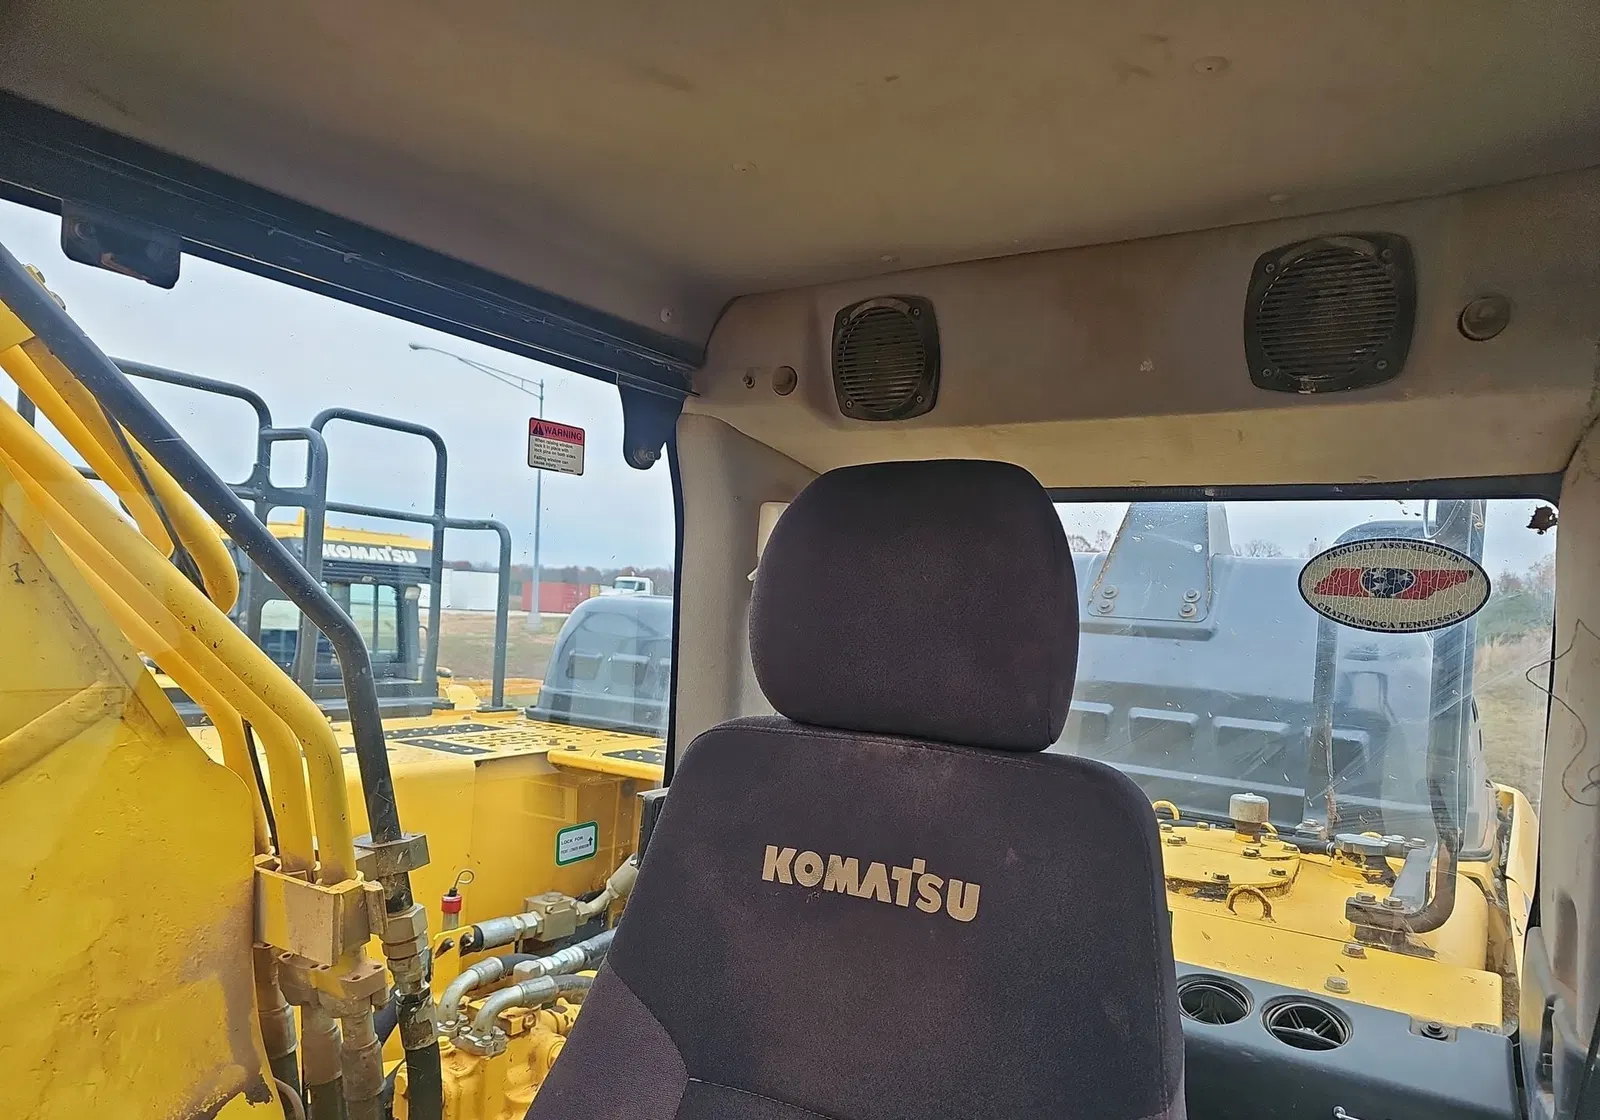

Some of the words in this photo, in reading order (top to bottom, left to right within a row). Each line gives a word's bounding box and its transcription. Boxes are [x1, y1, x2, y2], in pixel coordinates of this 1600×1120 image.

[544, 425, 582, 440] WARNING
[533, 454, 547, 462] Falling
[322, 543, 418, 564] KOMATSU
[1325, 542, 1376, 561] PROUDLY
[1379, 542, 1447, 557] ASSEMBLED
[1447, 552, 1463, 564] IN
[1317, 602, 1396, 629] CHATTANOOGA
[1399, 609, 1465, 629] TENNESSEE
[762, 844, 981, 922] KOMATSU
